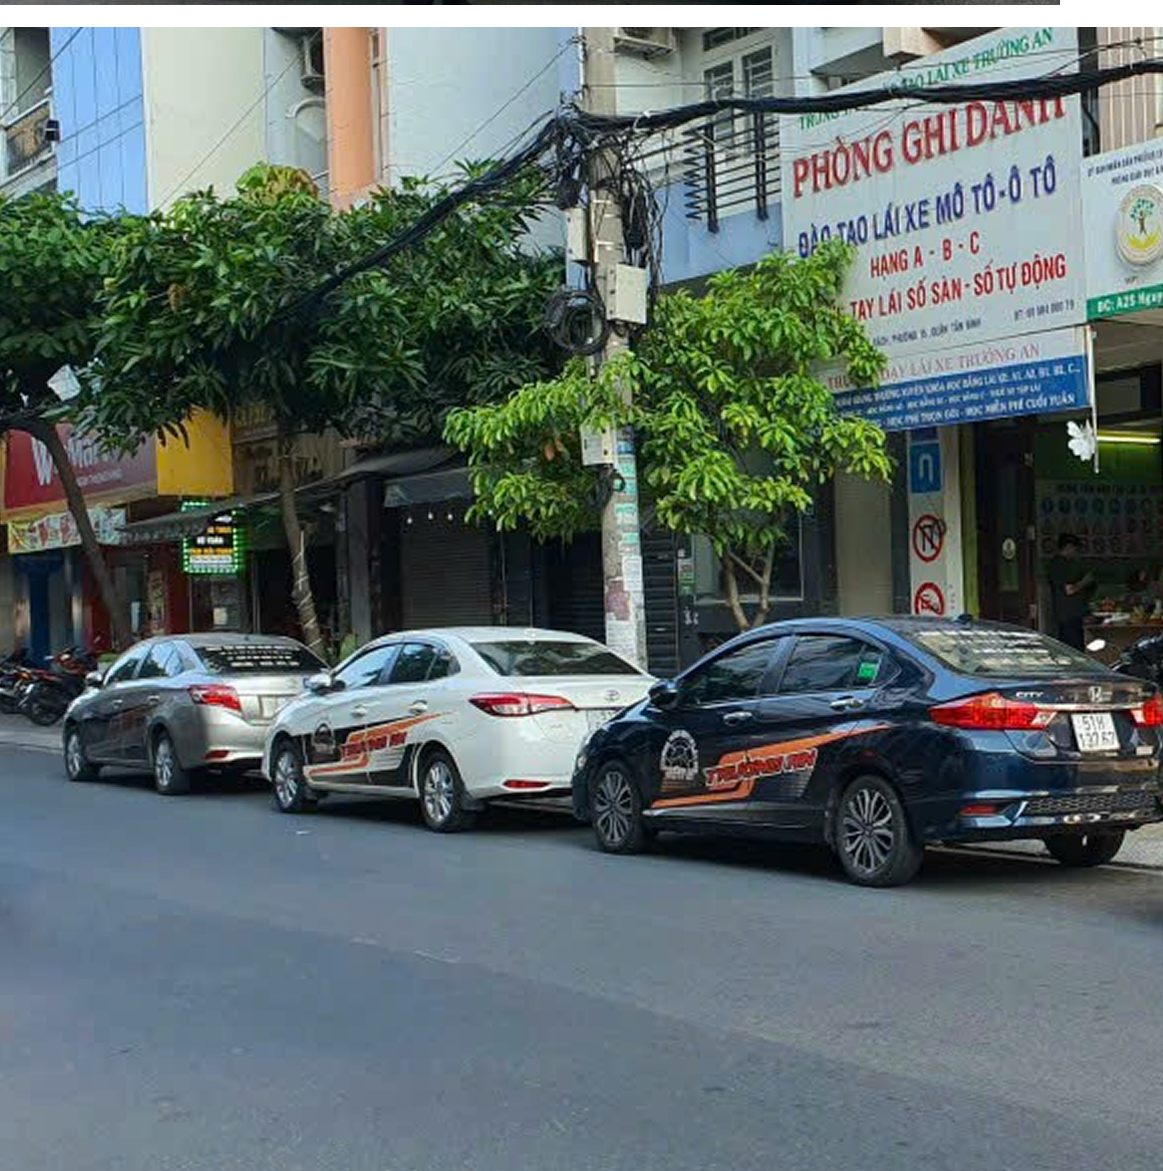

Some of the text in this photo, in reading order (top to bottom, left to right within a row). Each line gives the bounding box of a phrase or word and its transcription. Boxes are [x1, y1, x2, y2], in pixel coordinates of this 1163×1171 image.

[1031, 28, 1053, 48] AN
[793, 95, 1066, 198] PHÒNG GHI DANH
[873, 205, 901, 242] LÁI
[905, 199, 930, 234] XE
[935, 182, 965, 225] MÔ
[1030, 155, 1057, 198] TÔ
[850, 298, 875, 323] TAY
[879, 288, 903, 316] LÁI
[906, 276, 927, 312] SỐ
[931, 275, 963, 304] SÀN
[998, 261, 1020, 295] TỰ
[1021, 253, 1067, 289] ĐỘNG
[870, 230, 981, 284] HẠNG A B C
[1020, 343, 1041, 360] AN
